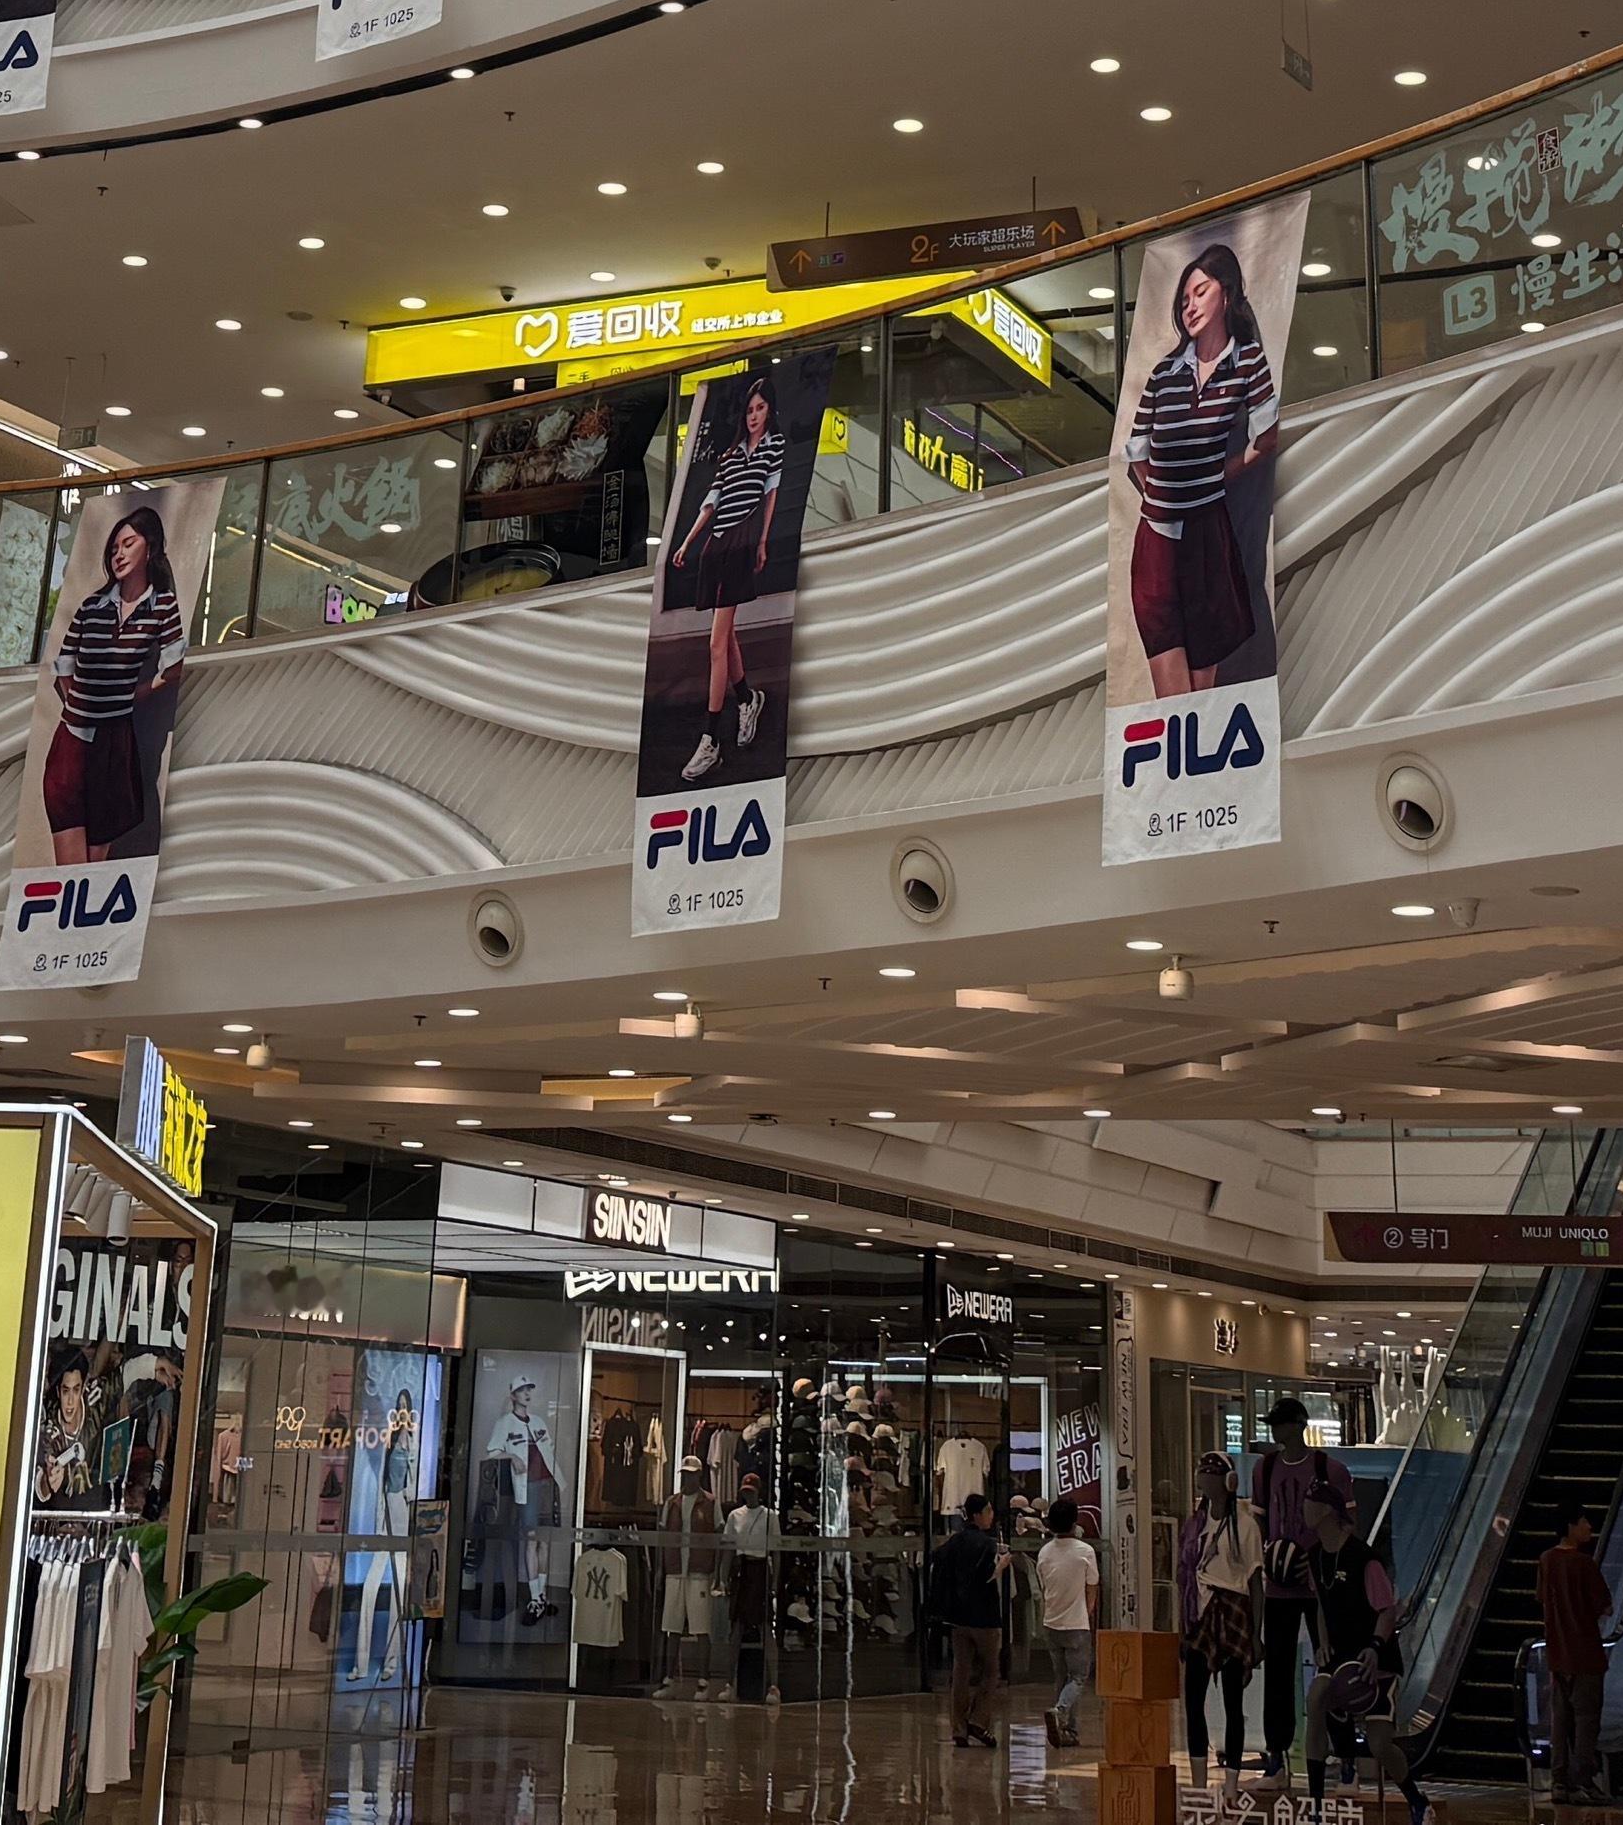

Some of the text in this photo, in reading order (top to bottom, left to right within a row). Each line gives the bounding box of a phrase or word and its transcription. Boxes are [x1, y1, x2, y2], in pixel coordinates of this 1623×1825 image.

[361, 8, 415, 35] 1F 1025
[910, 235, 939, 263] 2F
[949, 225, 1035, 249] 大玩家超乐场
[1450, 285, 1490, 325] L3
[566, 300, 683, 348] 爱回收
[1123, 703, 1264, 787] FILA
[645, 798, 770, 869] FILA
[1163, 805, 1237, 835] 1F 1025
[18, 874, 137, 932] FILA
[683, 889, 743, 913] 1F 1025
[53, 951, 107, 969] 1F 1025
[1522, 1227, 1609, 1240] MUJI UNIQLO
